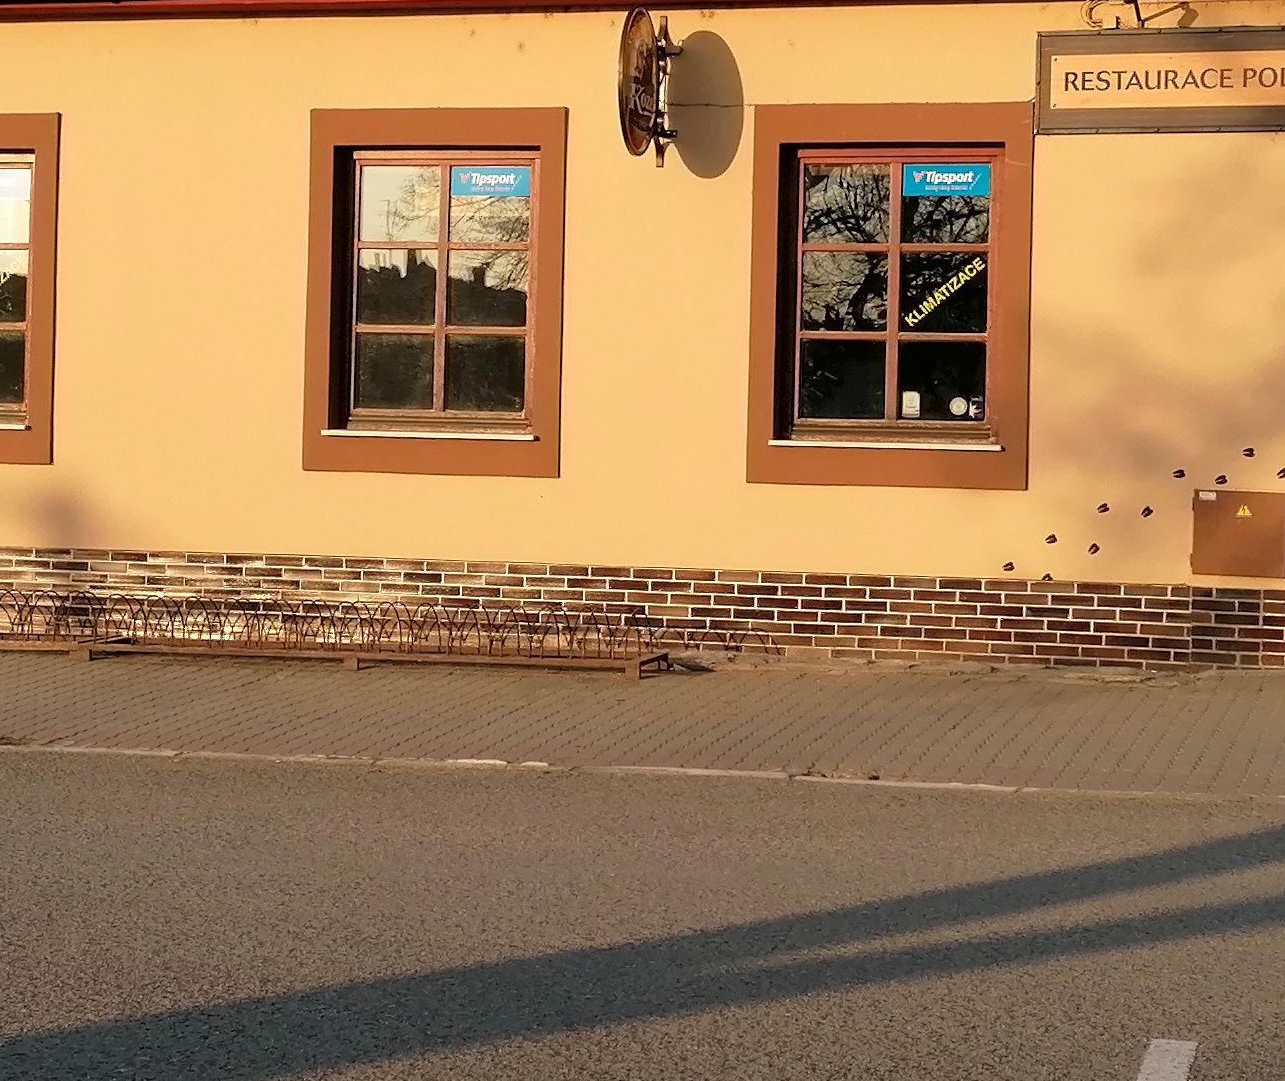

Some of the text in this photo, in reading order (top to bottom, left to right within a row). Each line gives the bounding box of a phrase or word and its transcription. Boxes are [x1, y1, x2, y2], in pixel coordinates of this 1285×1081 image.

[1064, 69, 1234, 92] RESTAURACE
[470, 172, 516, 187] Tipsport
[925, 171, 975, 185] Tipsport
[904, 257, 986, 327] KLIMATIZACE
